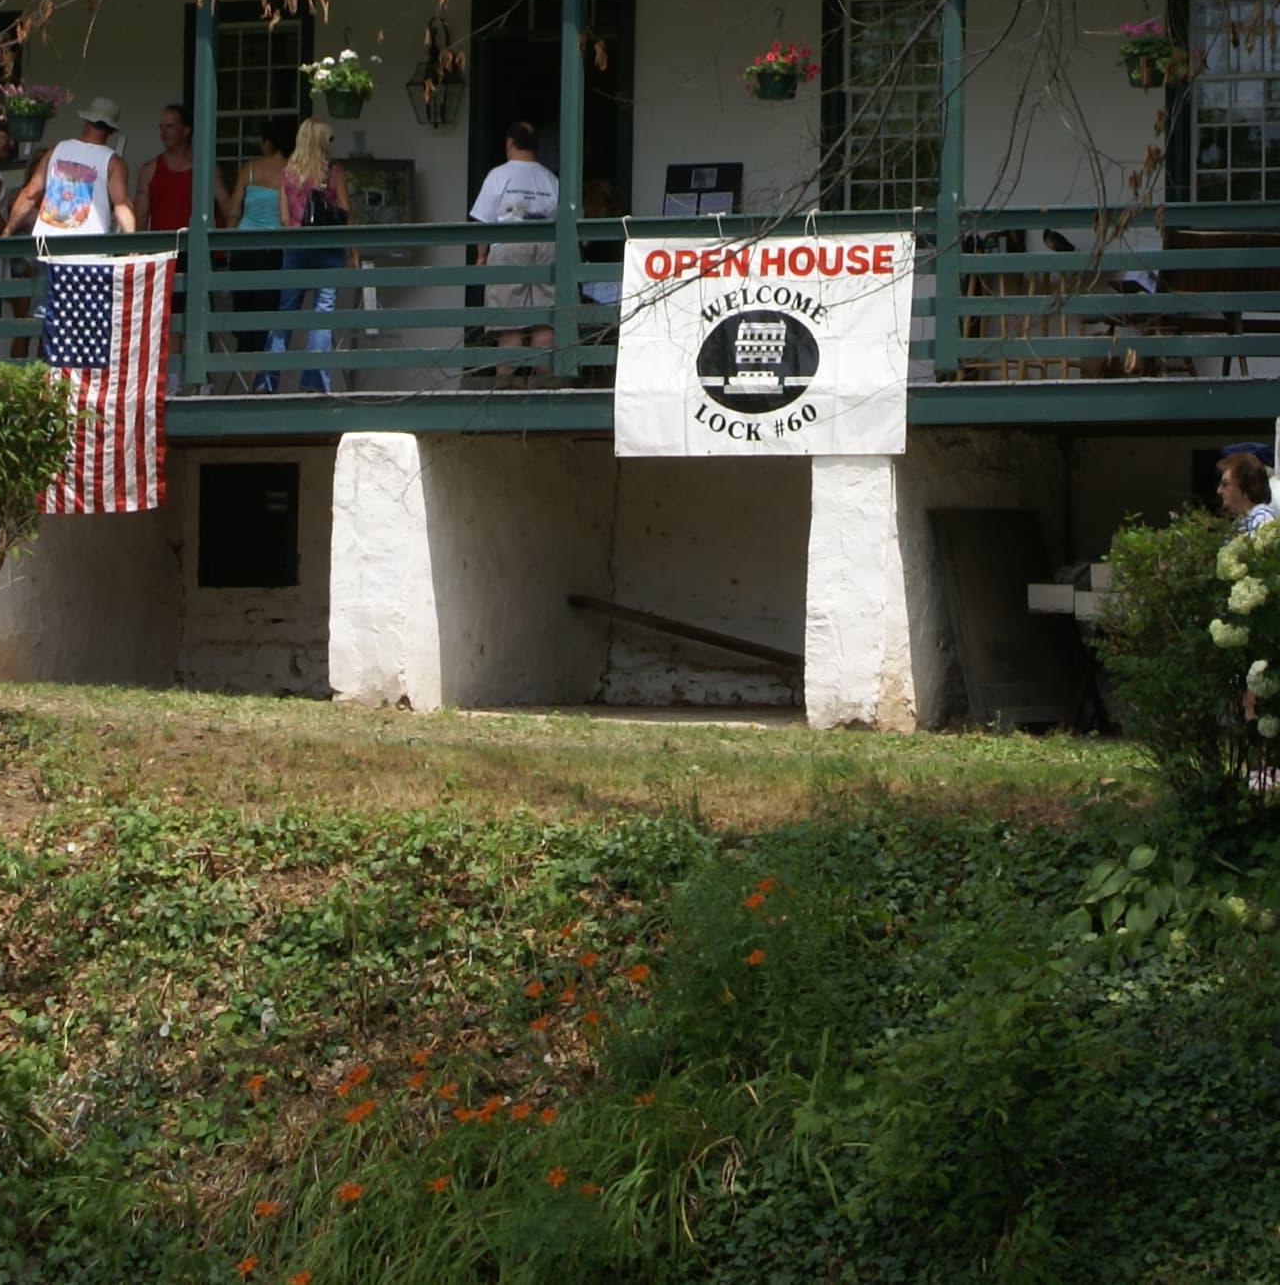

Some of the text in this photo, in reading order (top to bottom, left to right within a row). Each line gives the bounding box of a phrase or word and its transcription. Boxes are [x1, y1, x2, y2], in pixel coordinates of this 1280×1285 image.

[644, 244, 895, 280] OPEN HOUSE
[700, 285, 829, 325] WELCOME
[694, 402, 817, 441] LOCK #60
